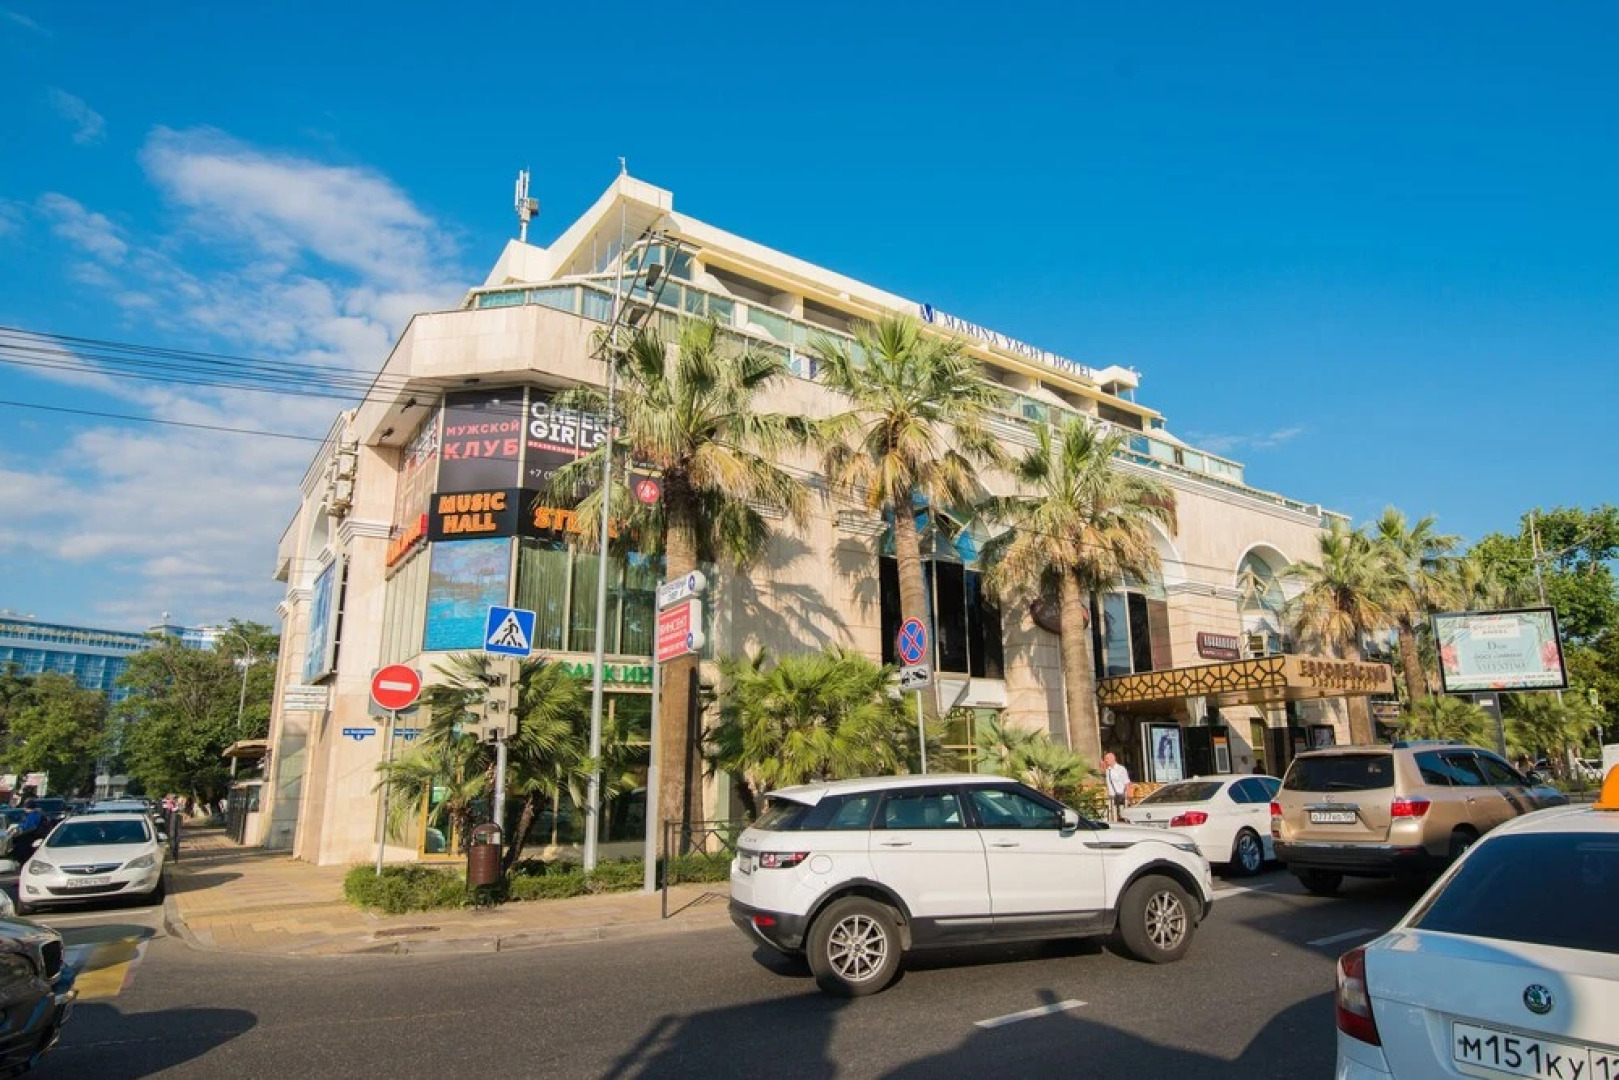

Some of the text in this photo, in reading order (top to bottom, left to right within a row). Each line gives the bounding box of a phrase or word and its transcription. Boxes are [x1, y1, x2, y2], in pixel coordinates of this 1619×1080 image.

[944, 314, 1094, 378] MARINA YACHT HOTEL
[446, 419, 520, 437] МУЖСКОЙ
[530, 420, 609, 448] GIRLS
[443, 438, 519, 460] КЛУБ
[438, 492, 506, 514] MUSIC
[443, 513, 497, 534] HALL
